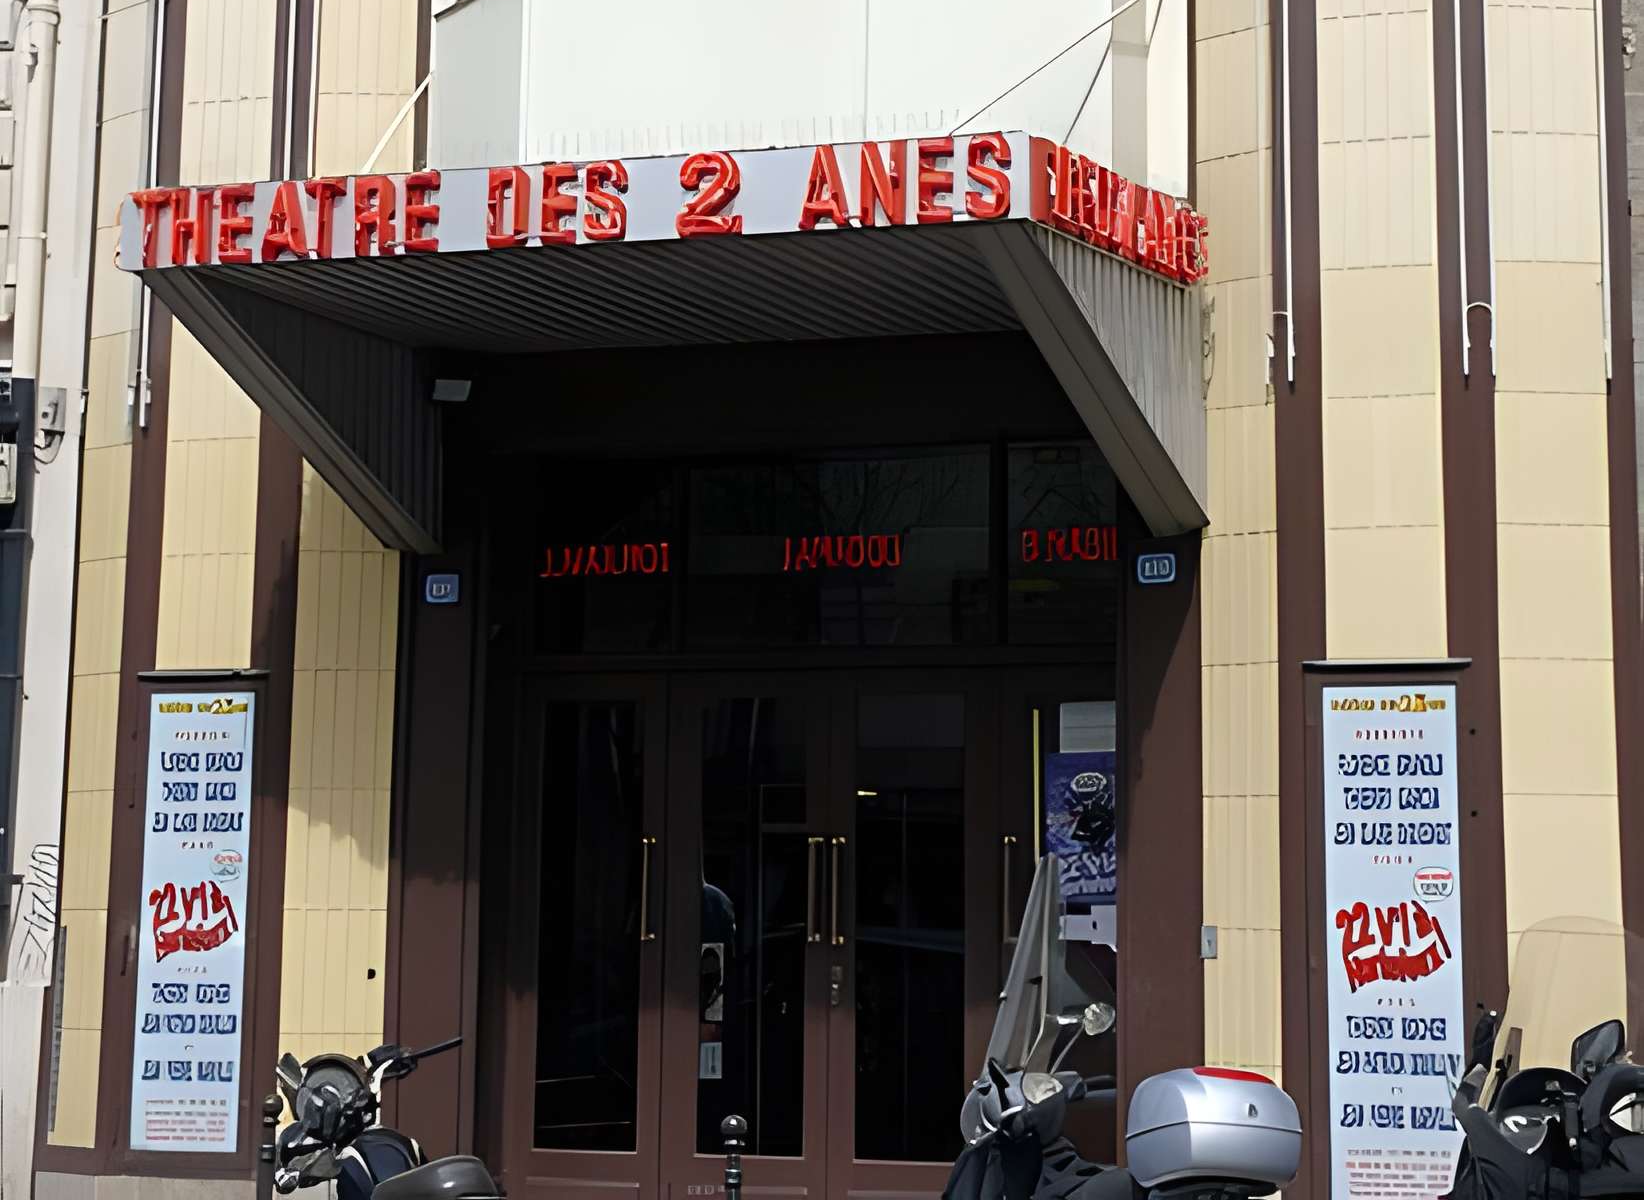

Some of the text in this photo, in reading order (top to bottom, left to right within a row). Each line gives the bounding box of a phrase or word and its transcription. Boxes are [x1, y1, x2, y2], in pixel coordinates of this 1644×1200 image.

[133, 168, 440, 268] THEATRE
[486, 159, 630, 250] DES
[676, 151, 742, 238] 2
[798, 131, 1012, 230] ANES
